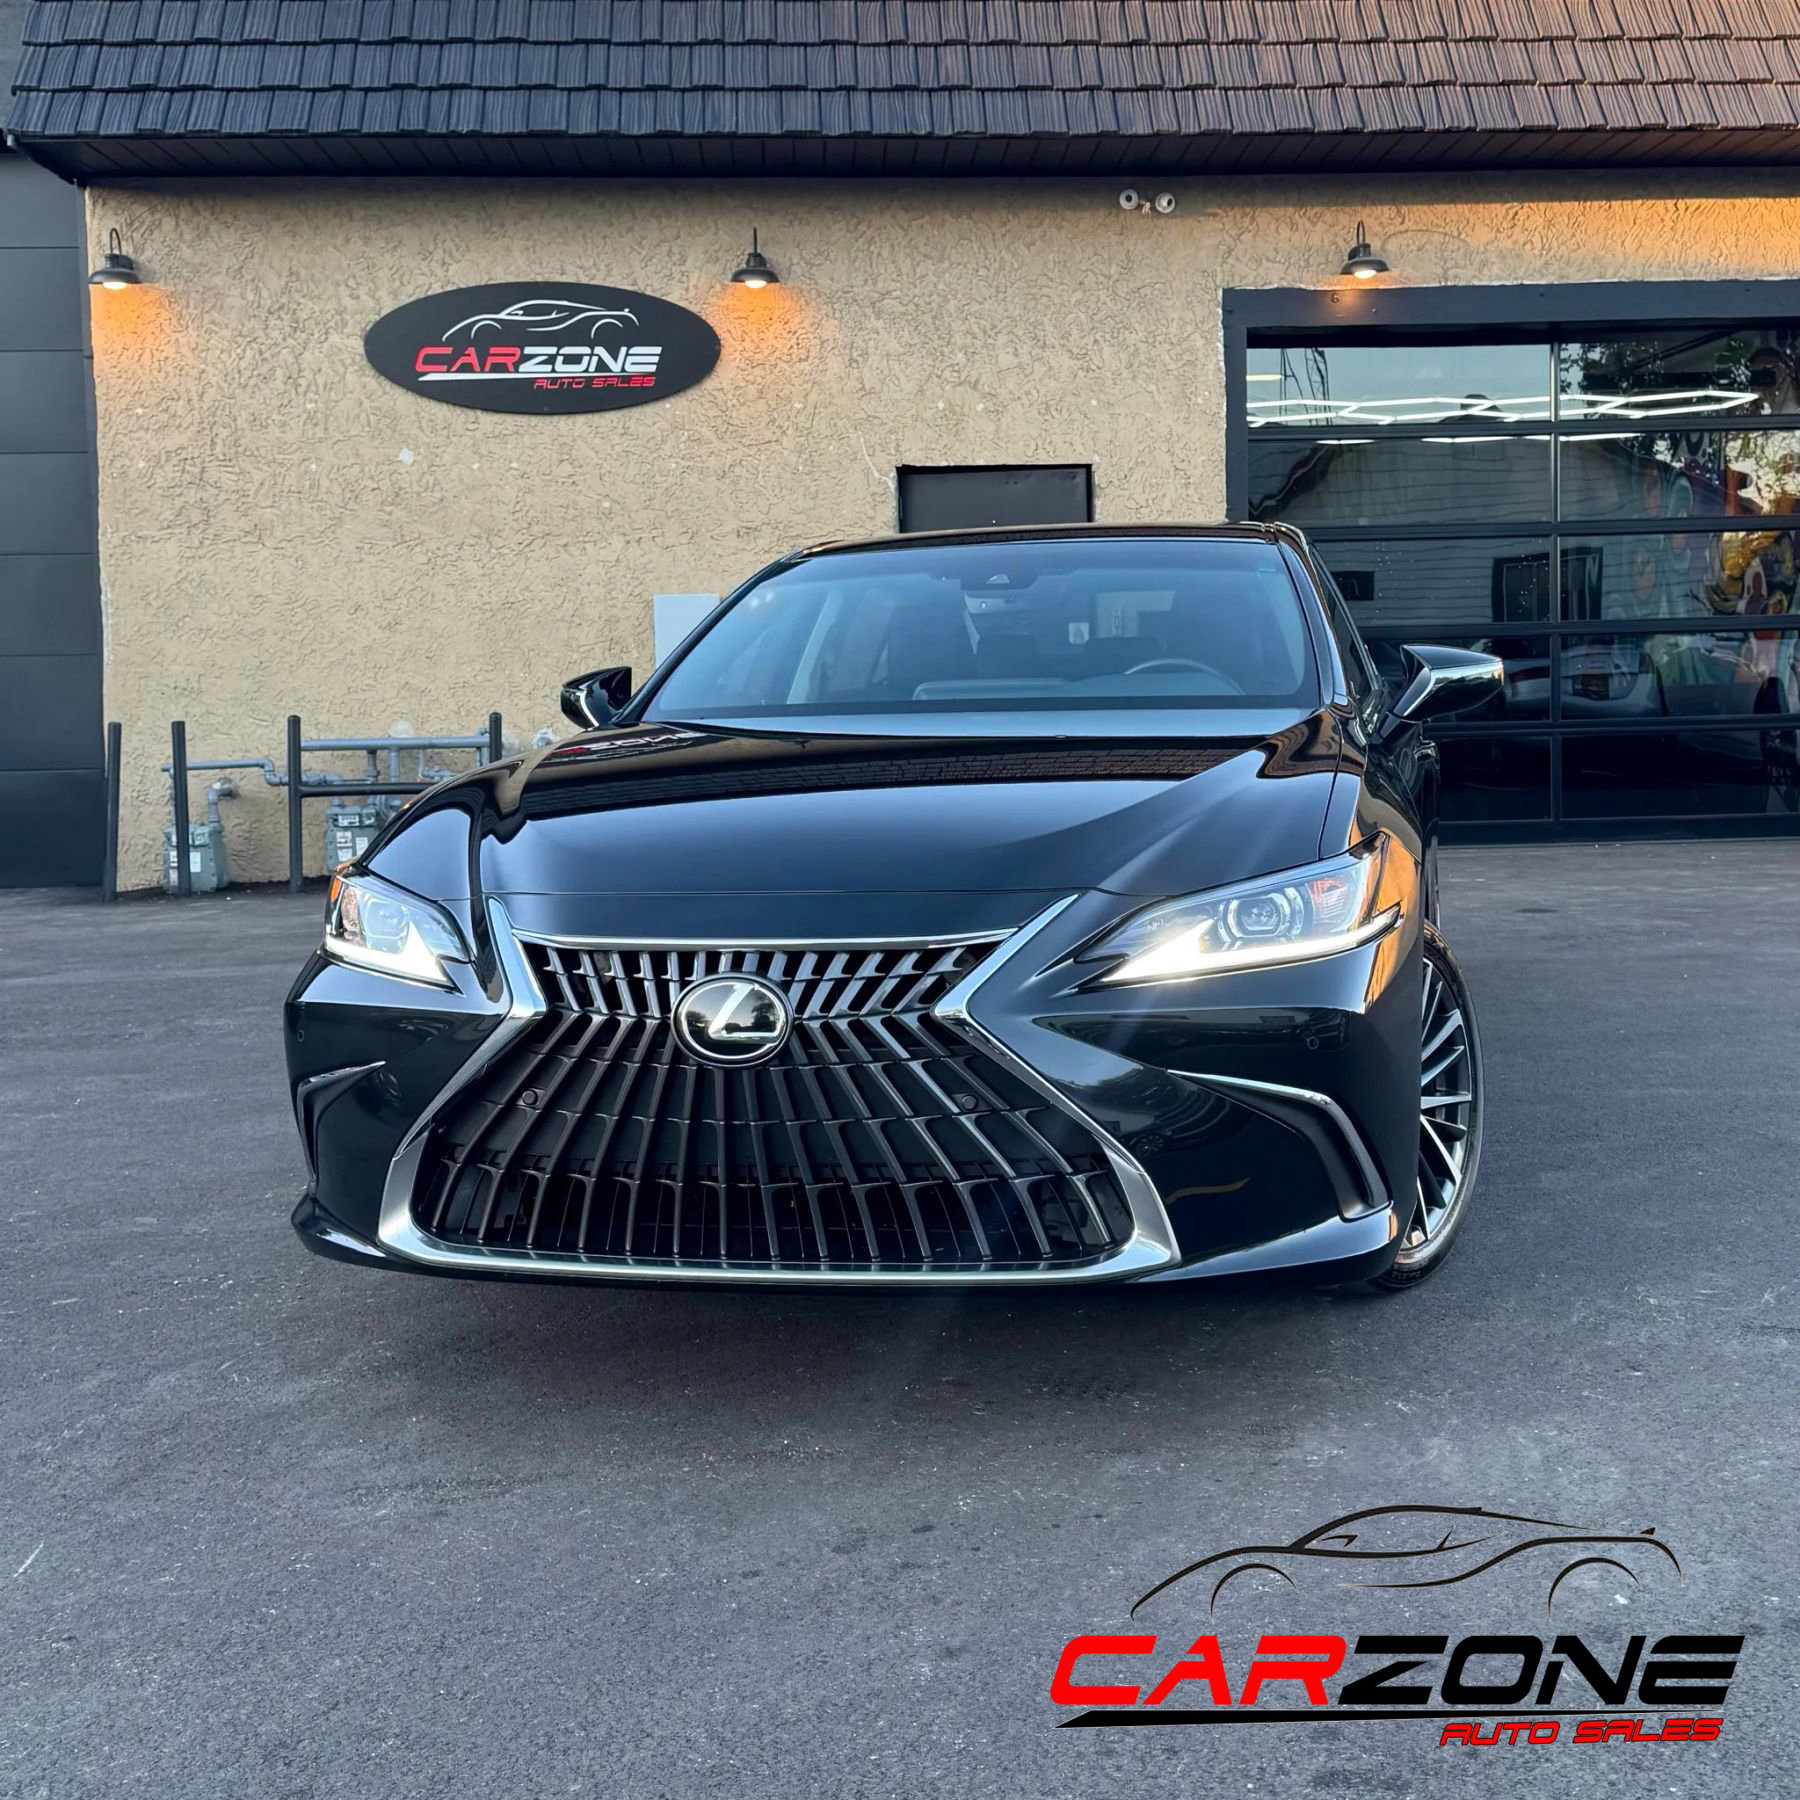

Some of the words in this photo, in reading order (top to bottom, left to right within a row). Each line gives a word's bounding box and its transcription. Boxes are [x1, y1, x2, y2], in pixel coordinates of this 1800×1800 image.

[415, 346, 662, 372] CARZONE
[533, 377, 584, 389] AUTO
[591, 375, 655, 388] SALES
